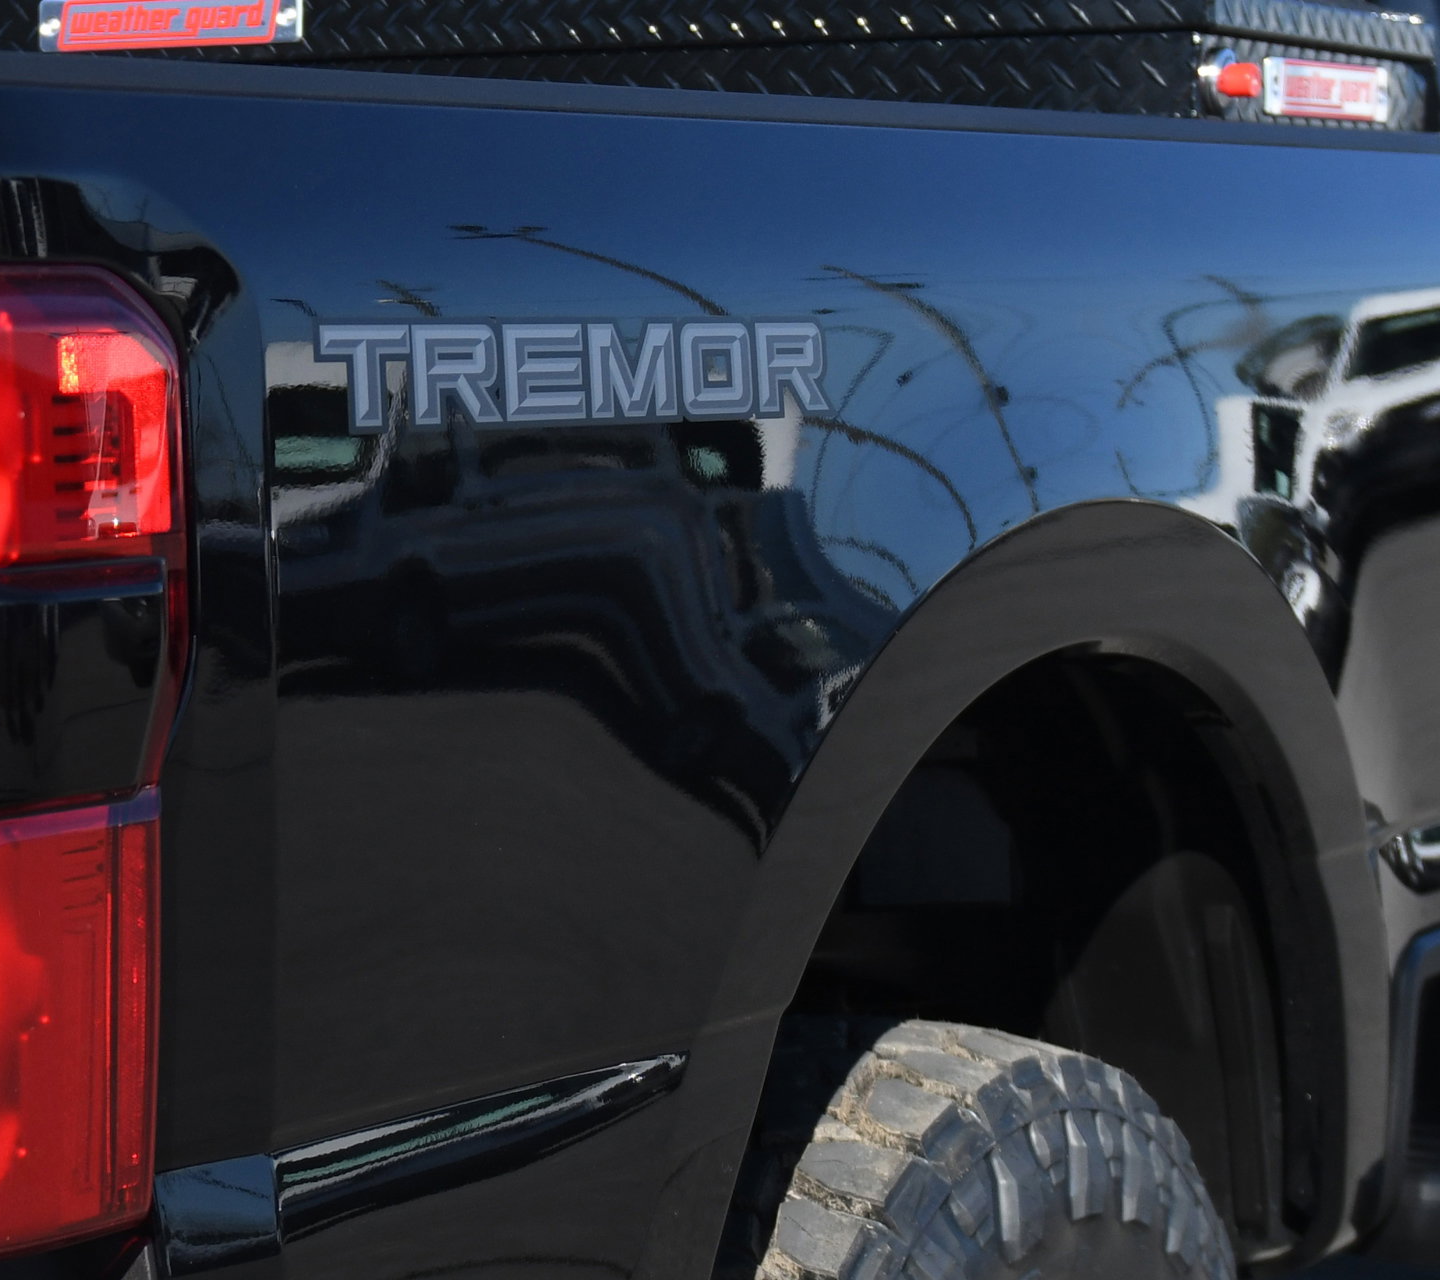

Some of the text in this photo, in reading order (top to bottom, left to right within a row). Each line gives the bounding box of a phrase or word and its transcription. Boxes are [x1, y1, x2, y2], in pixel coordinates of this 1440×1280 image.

[70, 0, 264, 34] weather guard
[316, 319, 833, 430] TREMOR
